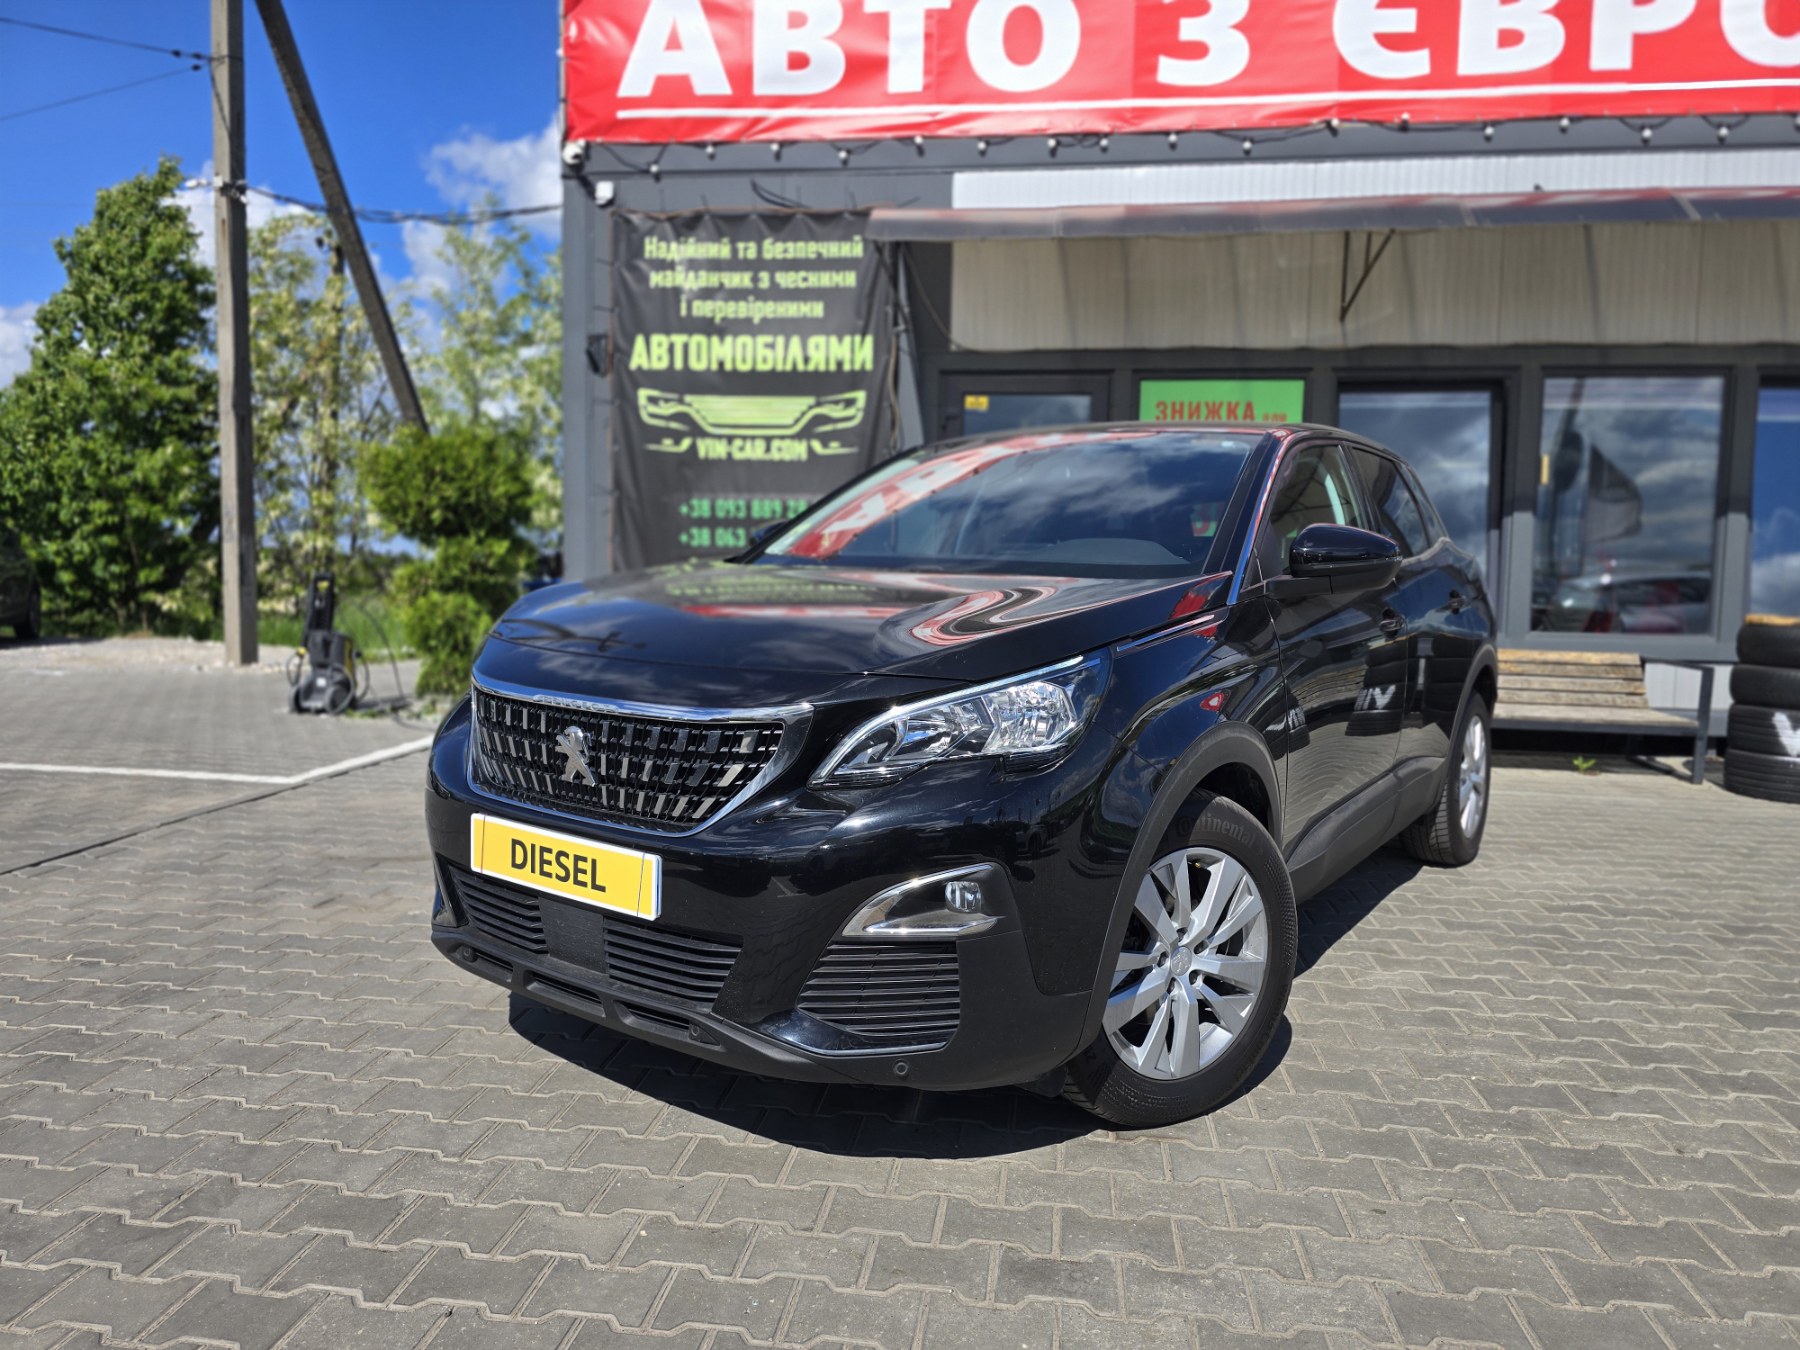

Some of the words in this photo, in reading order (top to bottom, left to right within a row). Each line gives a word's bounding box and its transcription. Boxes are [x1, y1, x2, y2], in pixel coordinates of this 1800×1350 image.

[617, 0, 1081, 98] АВТО
[1157, 0, 1250, 86] З
[736, 241, 757, 260] та
[762, 236, 864, 260] безпечний
[649, 266, 754, 291] майданчик
[775, 270, 857, 289] чесними
[691, 296, 825, 325] перевіреними
[628, 332, 875, 373] АВТОМОБІЛЯМИ
[1154, 400, 1255, 422] ЗНИЖКА
[510, 838, 607, 893] DIESEL
